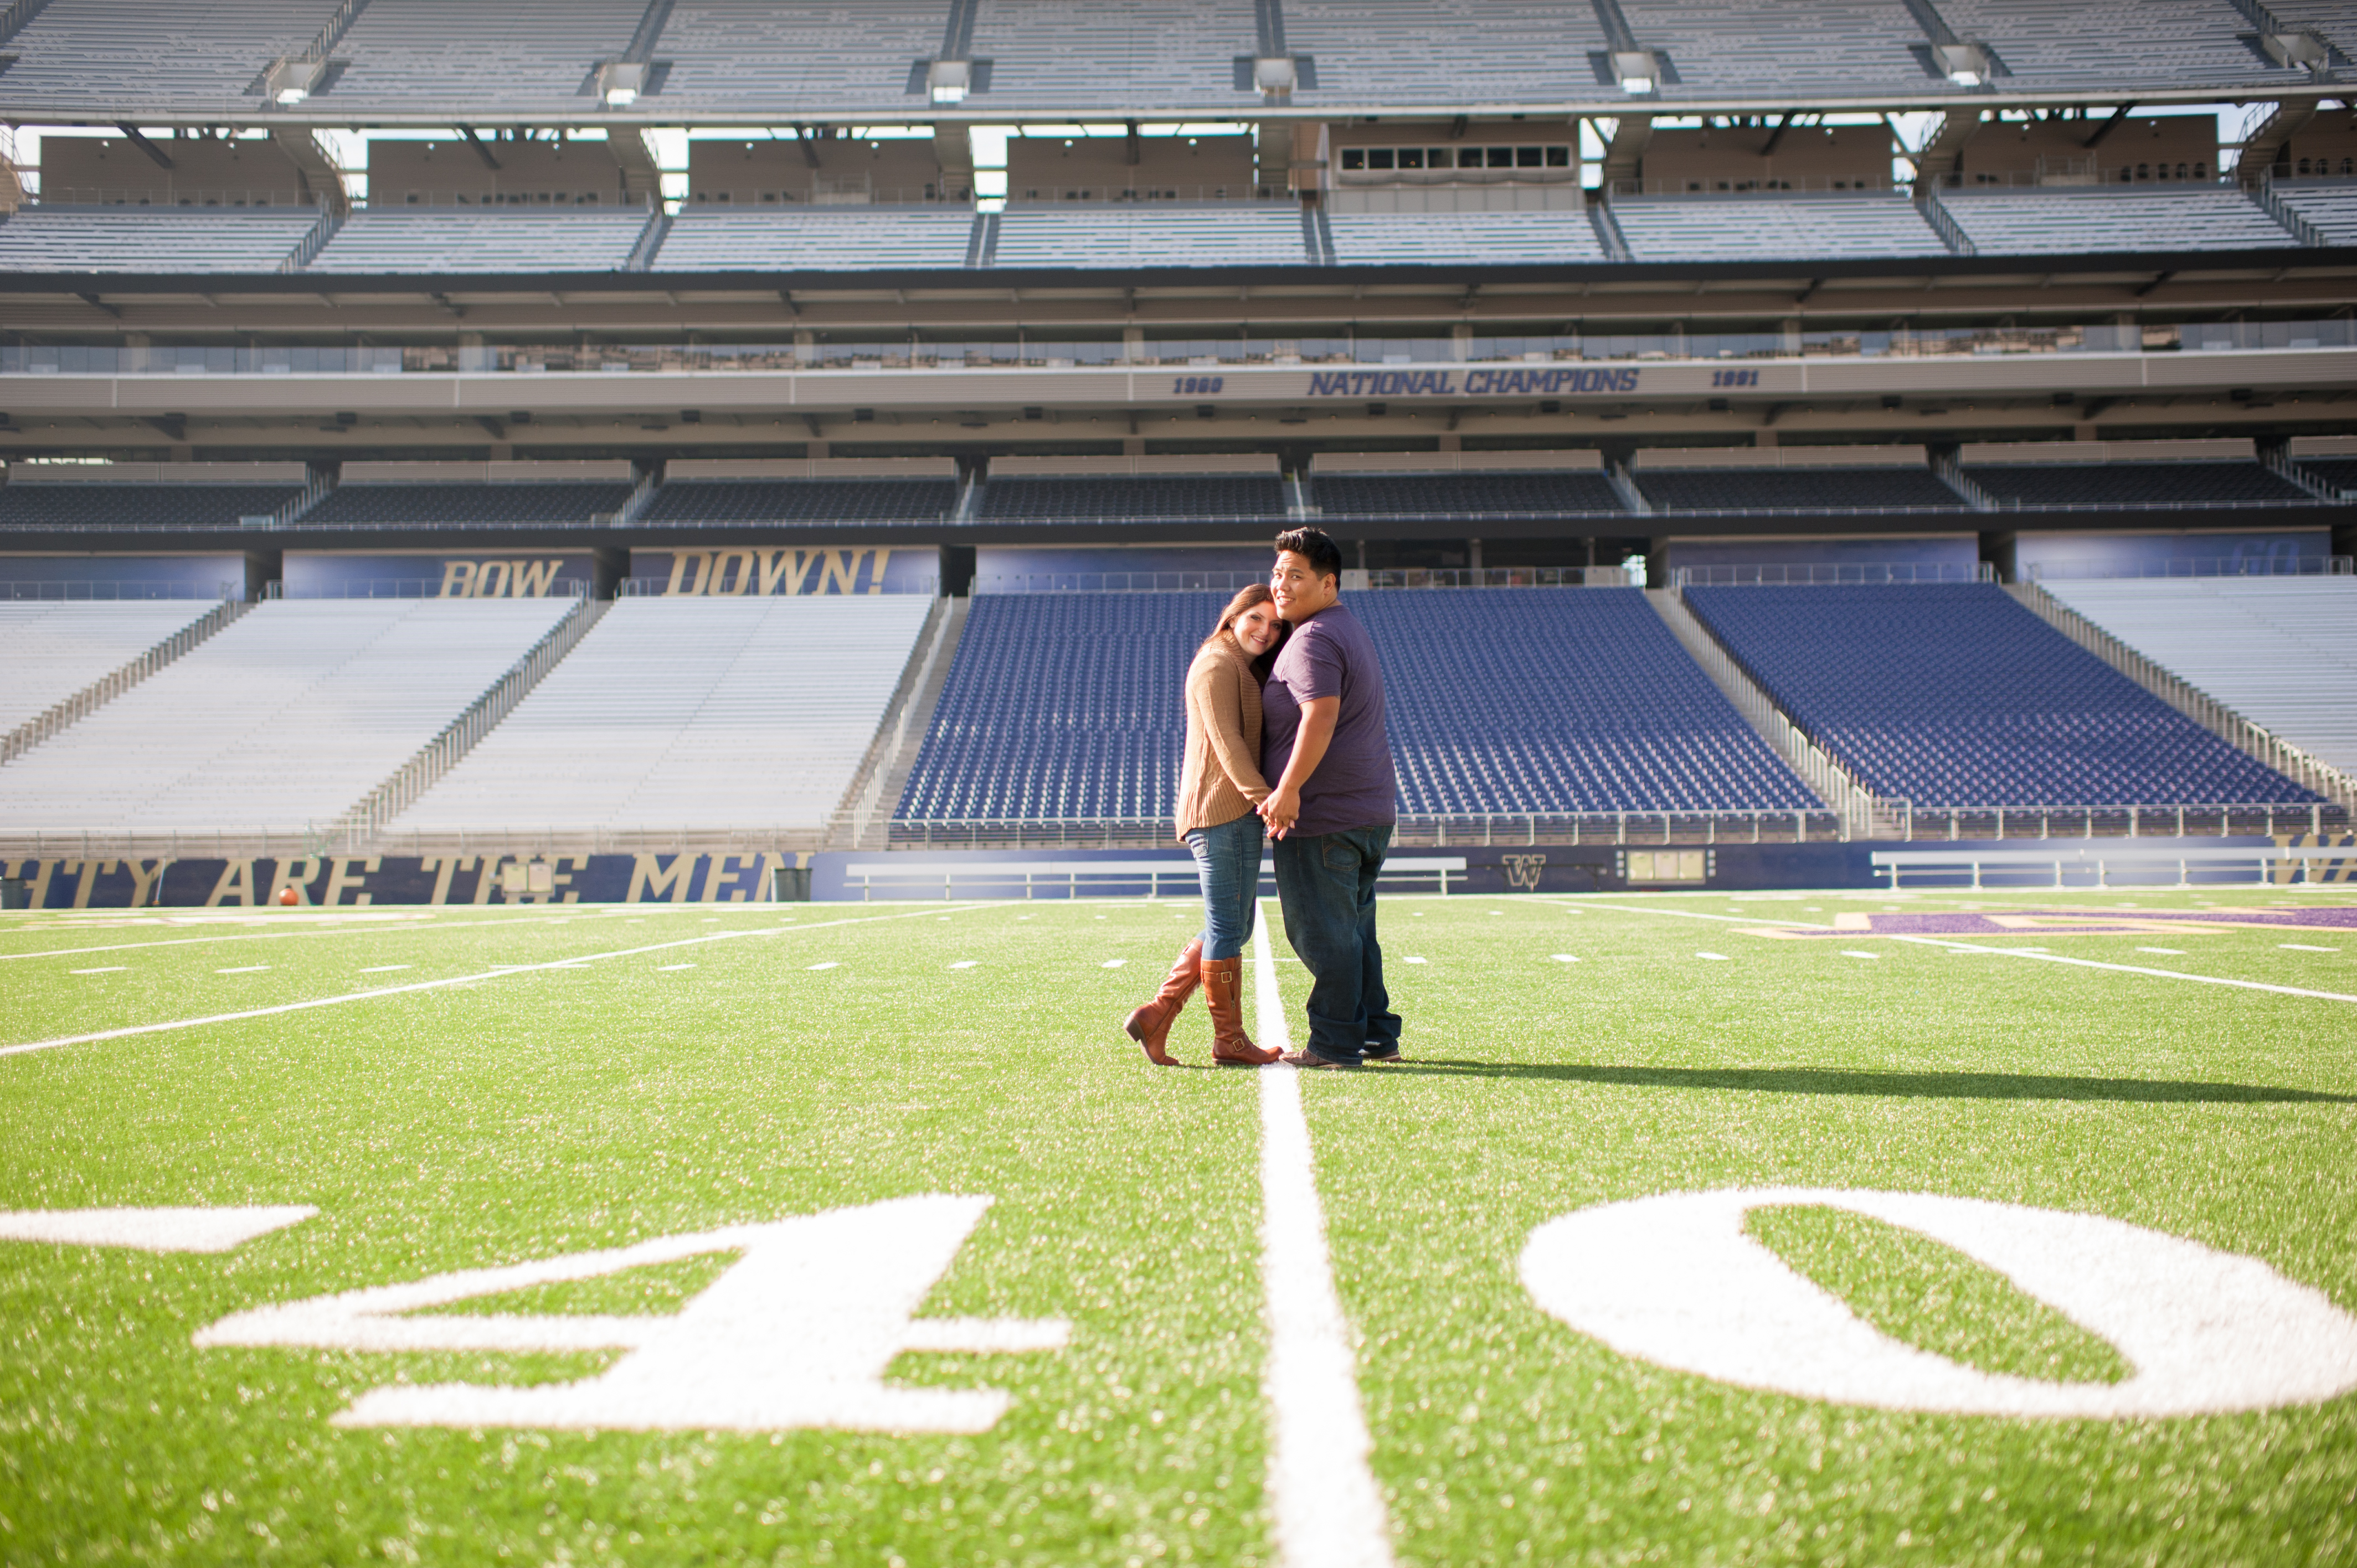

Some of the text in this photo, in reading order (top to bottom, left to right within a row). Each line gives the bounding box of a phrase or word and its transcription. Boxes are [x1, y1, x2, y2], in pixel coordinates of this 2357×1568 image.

[1174, 376, 1223, 394] 1960
[1308, 370, 1455, 395] NATIONAL
[1464, 368, 1640, 394] CHAMPIONS
[436, 550, 892, 599] BOW DOWN!
[205, 857, 383, 906] ARE
[420, 854, 590, 905] THE
[1502, 854, 1546, 886] W
